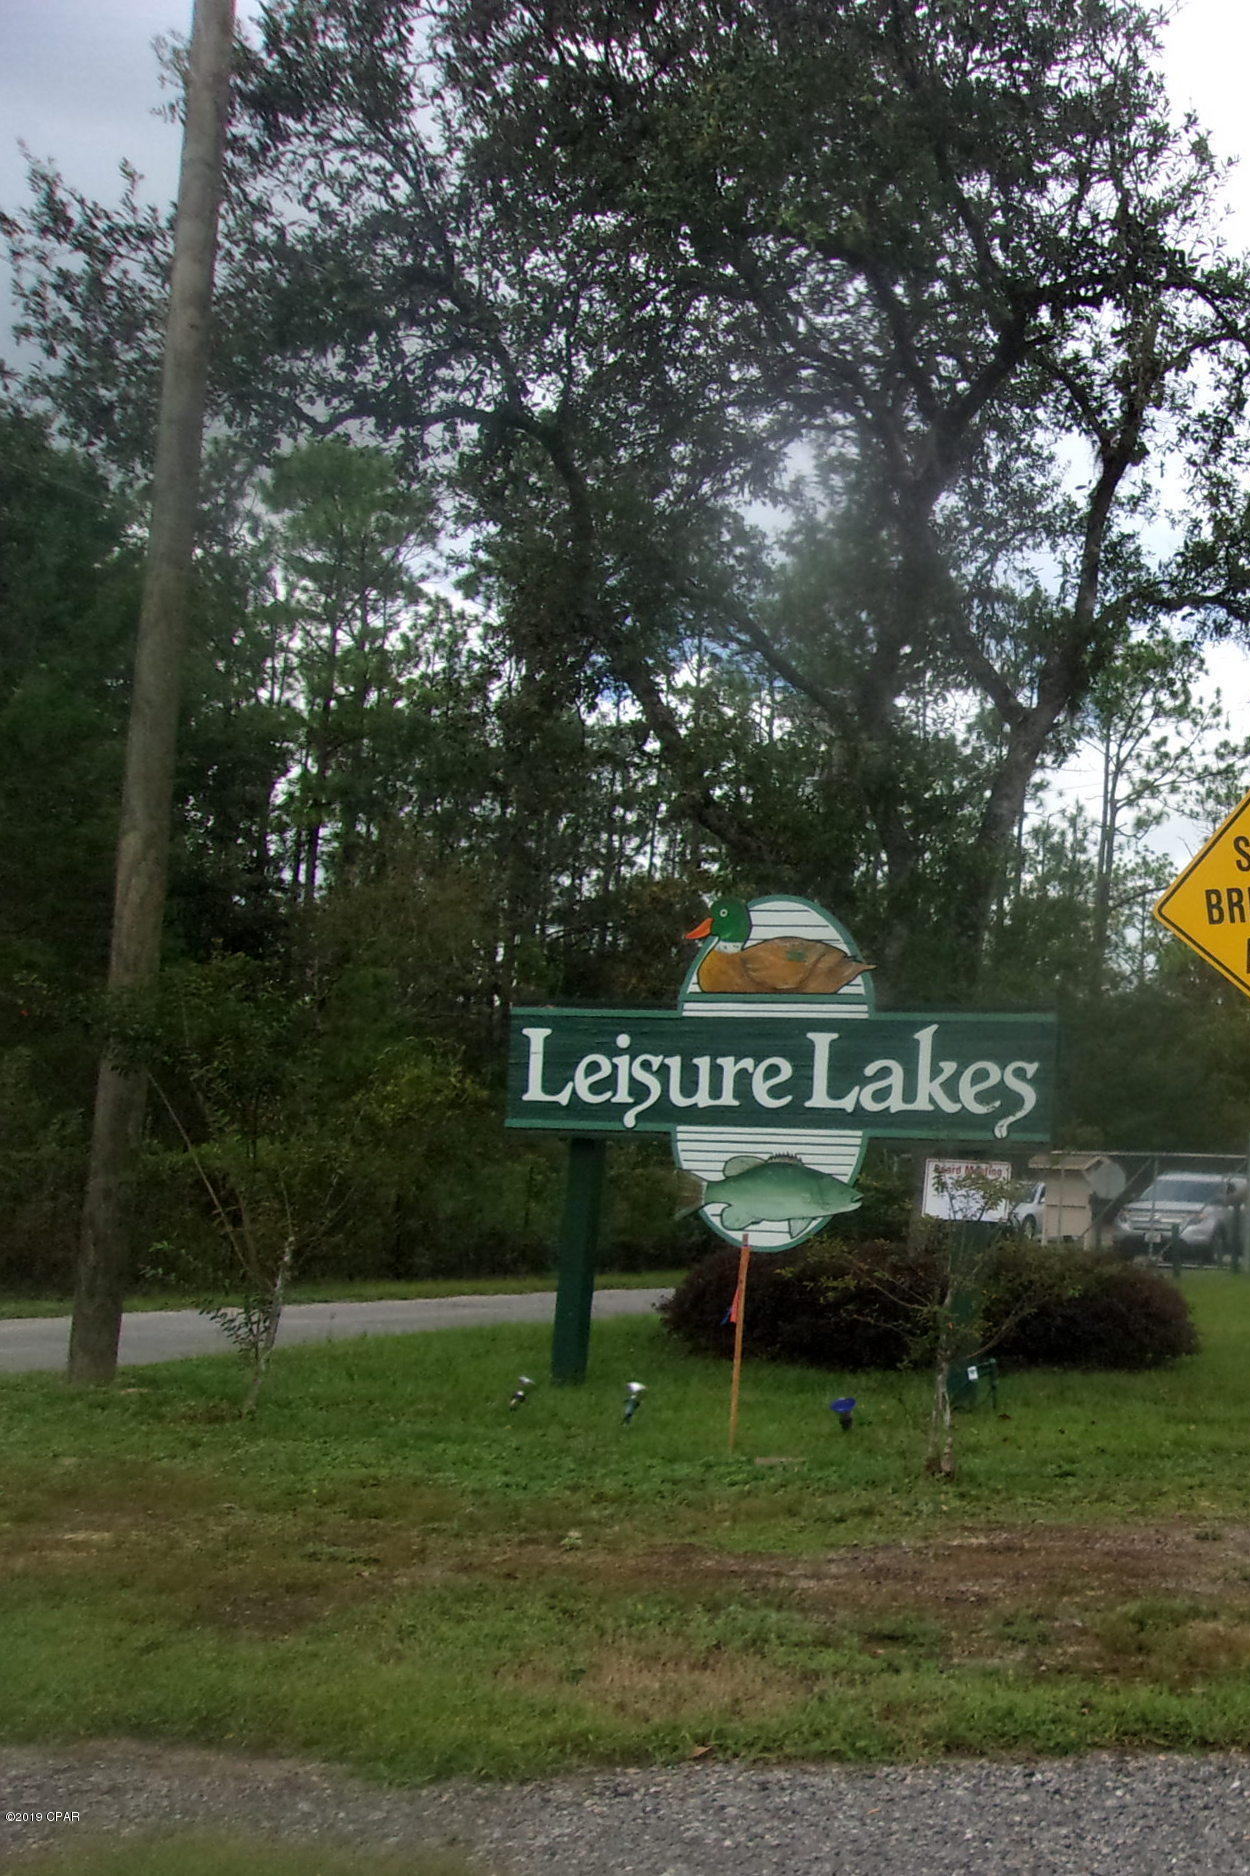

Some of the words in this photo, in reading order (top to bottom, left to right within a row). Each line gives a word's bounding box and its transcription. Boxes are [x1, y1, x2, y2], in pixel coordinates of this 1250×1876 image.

[521, 1027, 793, 1128] Leisure
[804, 1023, 1039, 1138] Lakes
[964, 1164, 1003, 1177] Mting
